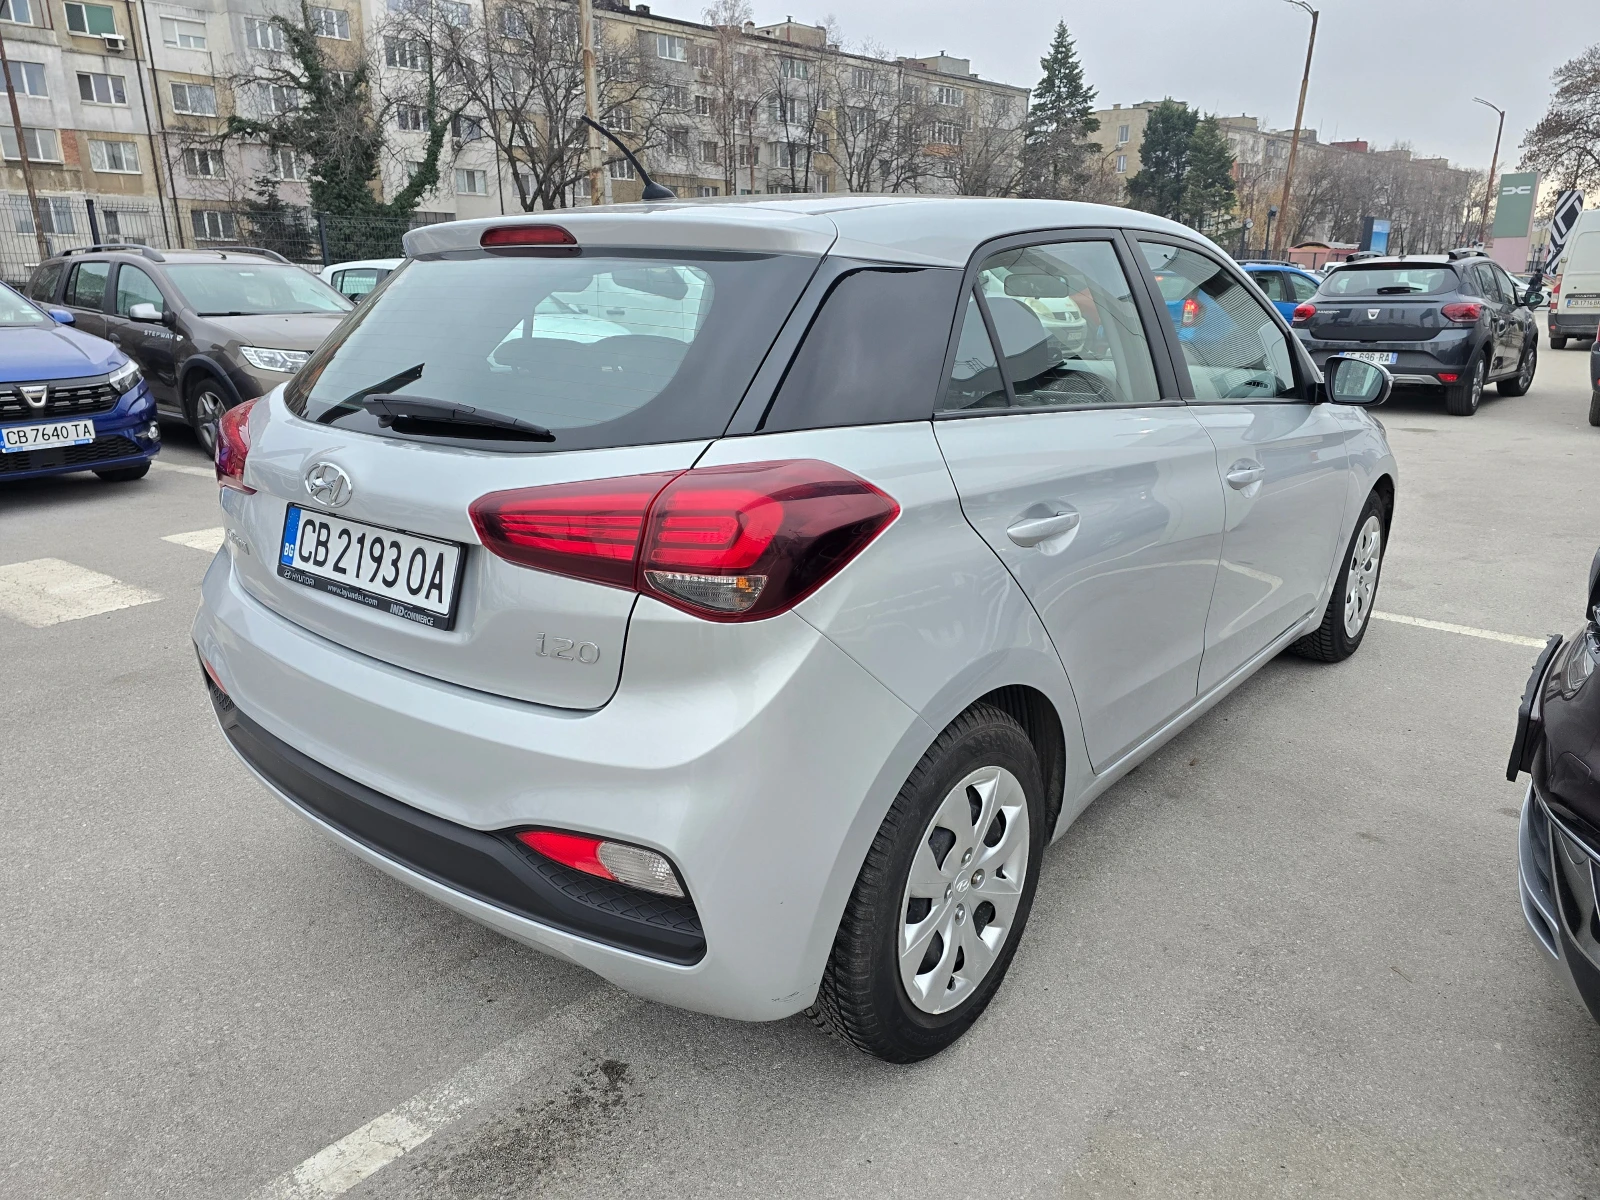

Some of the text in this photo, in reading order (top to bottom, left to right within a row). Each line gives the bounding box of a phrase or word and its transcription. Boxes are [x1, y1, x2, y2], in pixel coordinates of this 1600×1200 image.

[144, 329, 175, 340] STEPWAY
[283, 542, 294, 558] BG
[291, 572, 315, 586] HYUNDAI
[326, 584, 378, 607] www.hyundai.com
